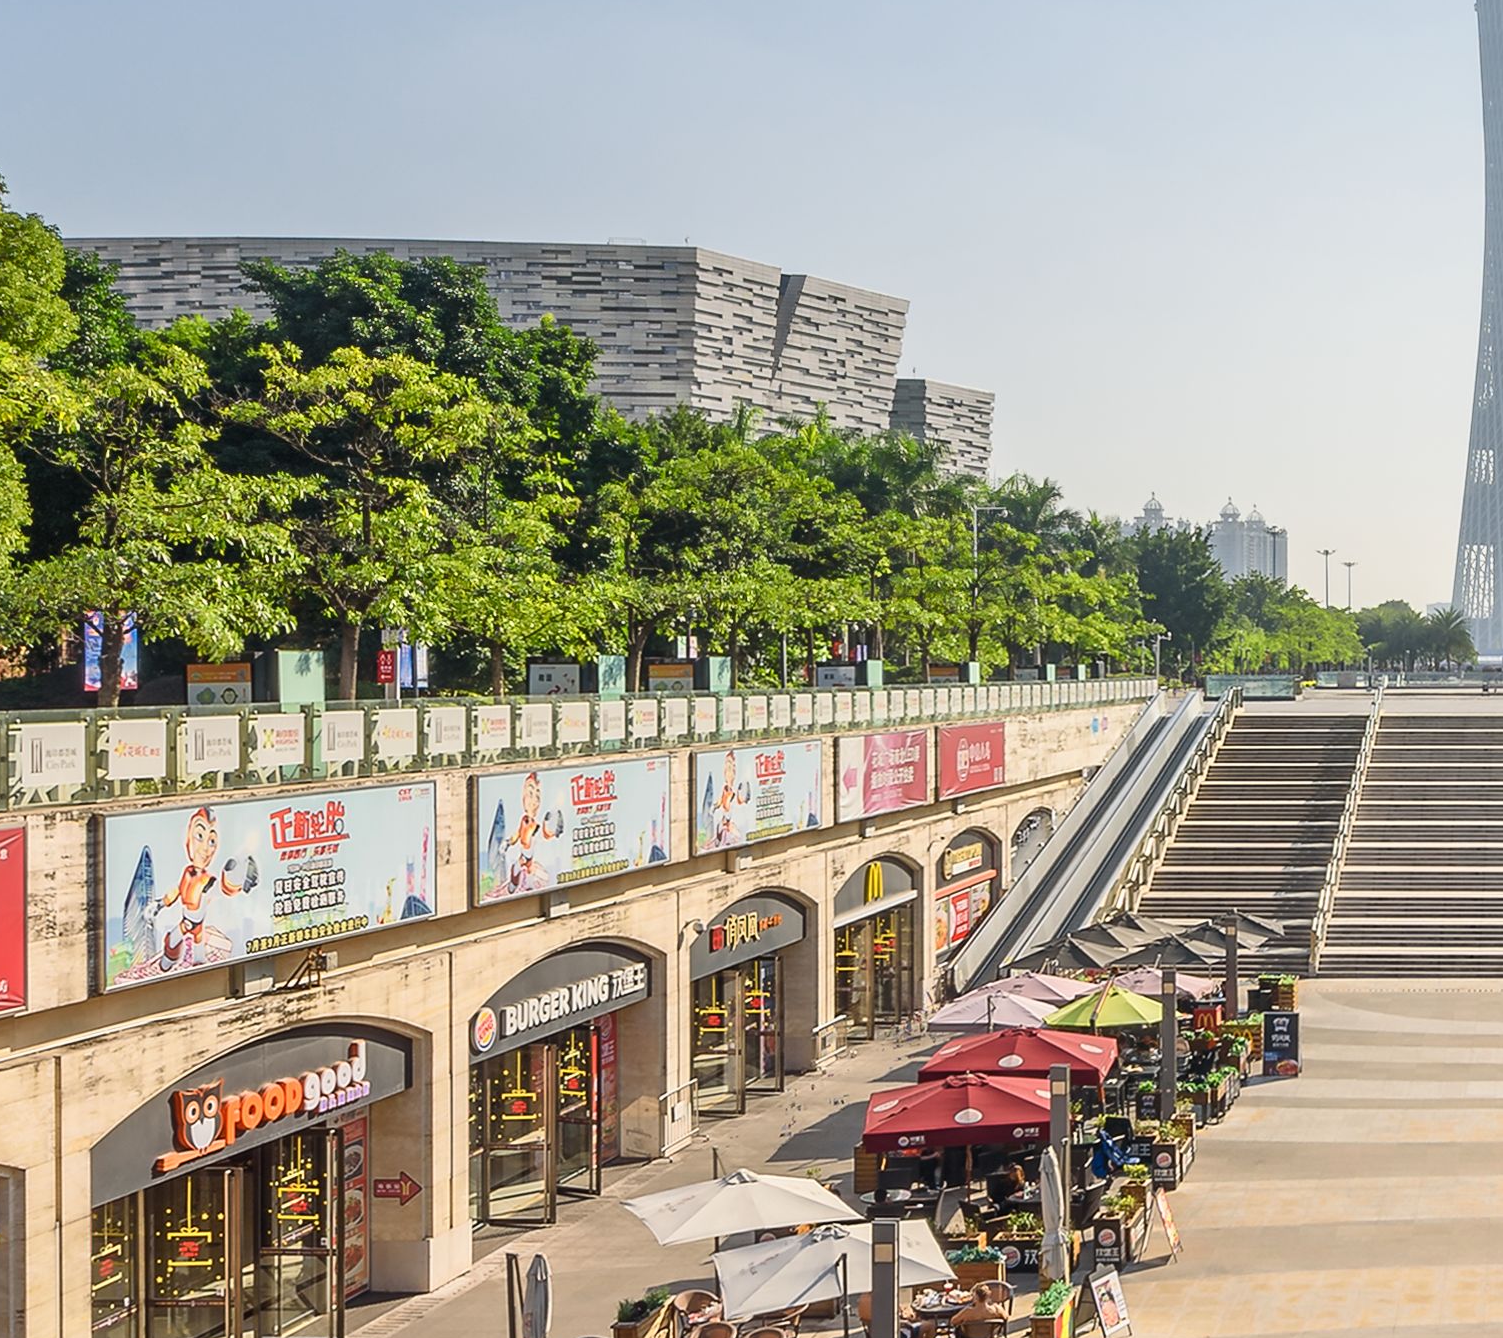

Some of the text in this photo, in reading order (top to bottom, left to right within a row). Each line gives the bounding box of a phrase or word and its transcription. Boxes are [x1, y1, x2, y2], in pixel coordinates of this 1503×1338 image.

[269, 801, 350, 849] 正新轮胎
[505, 963, 646, 1037] BURGER KING 汉堡王
